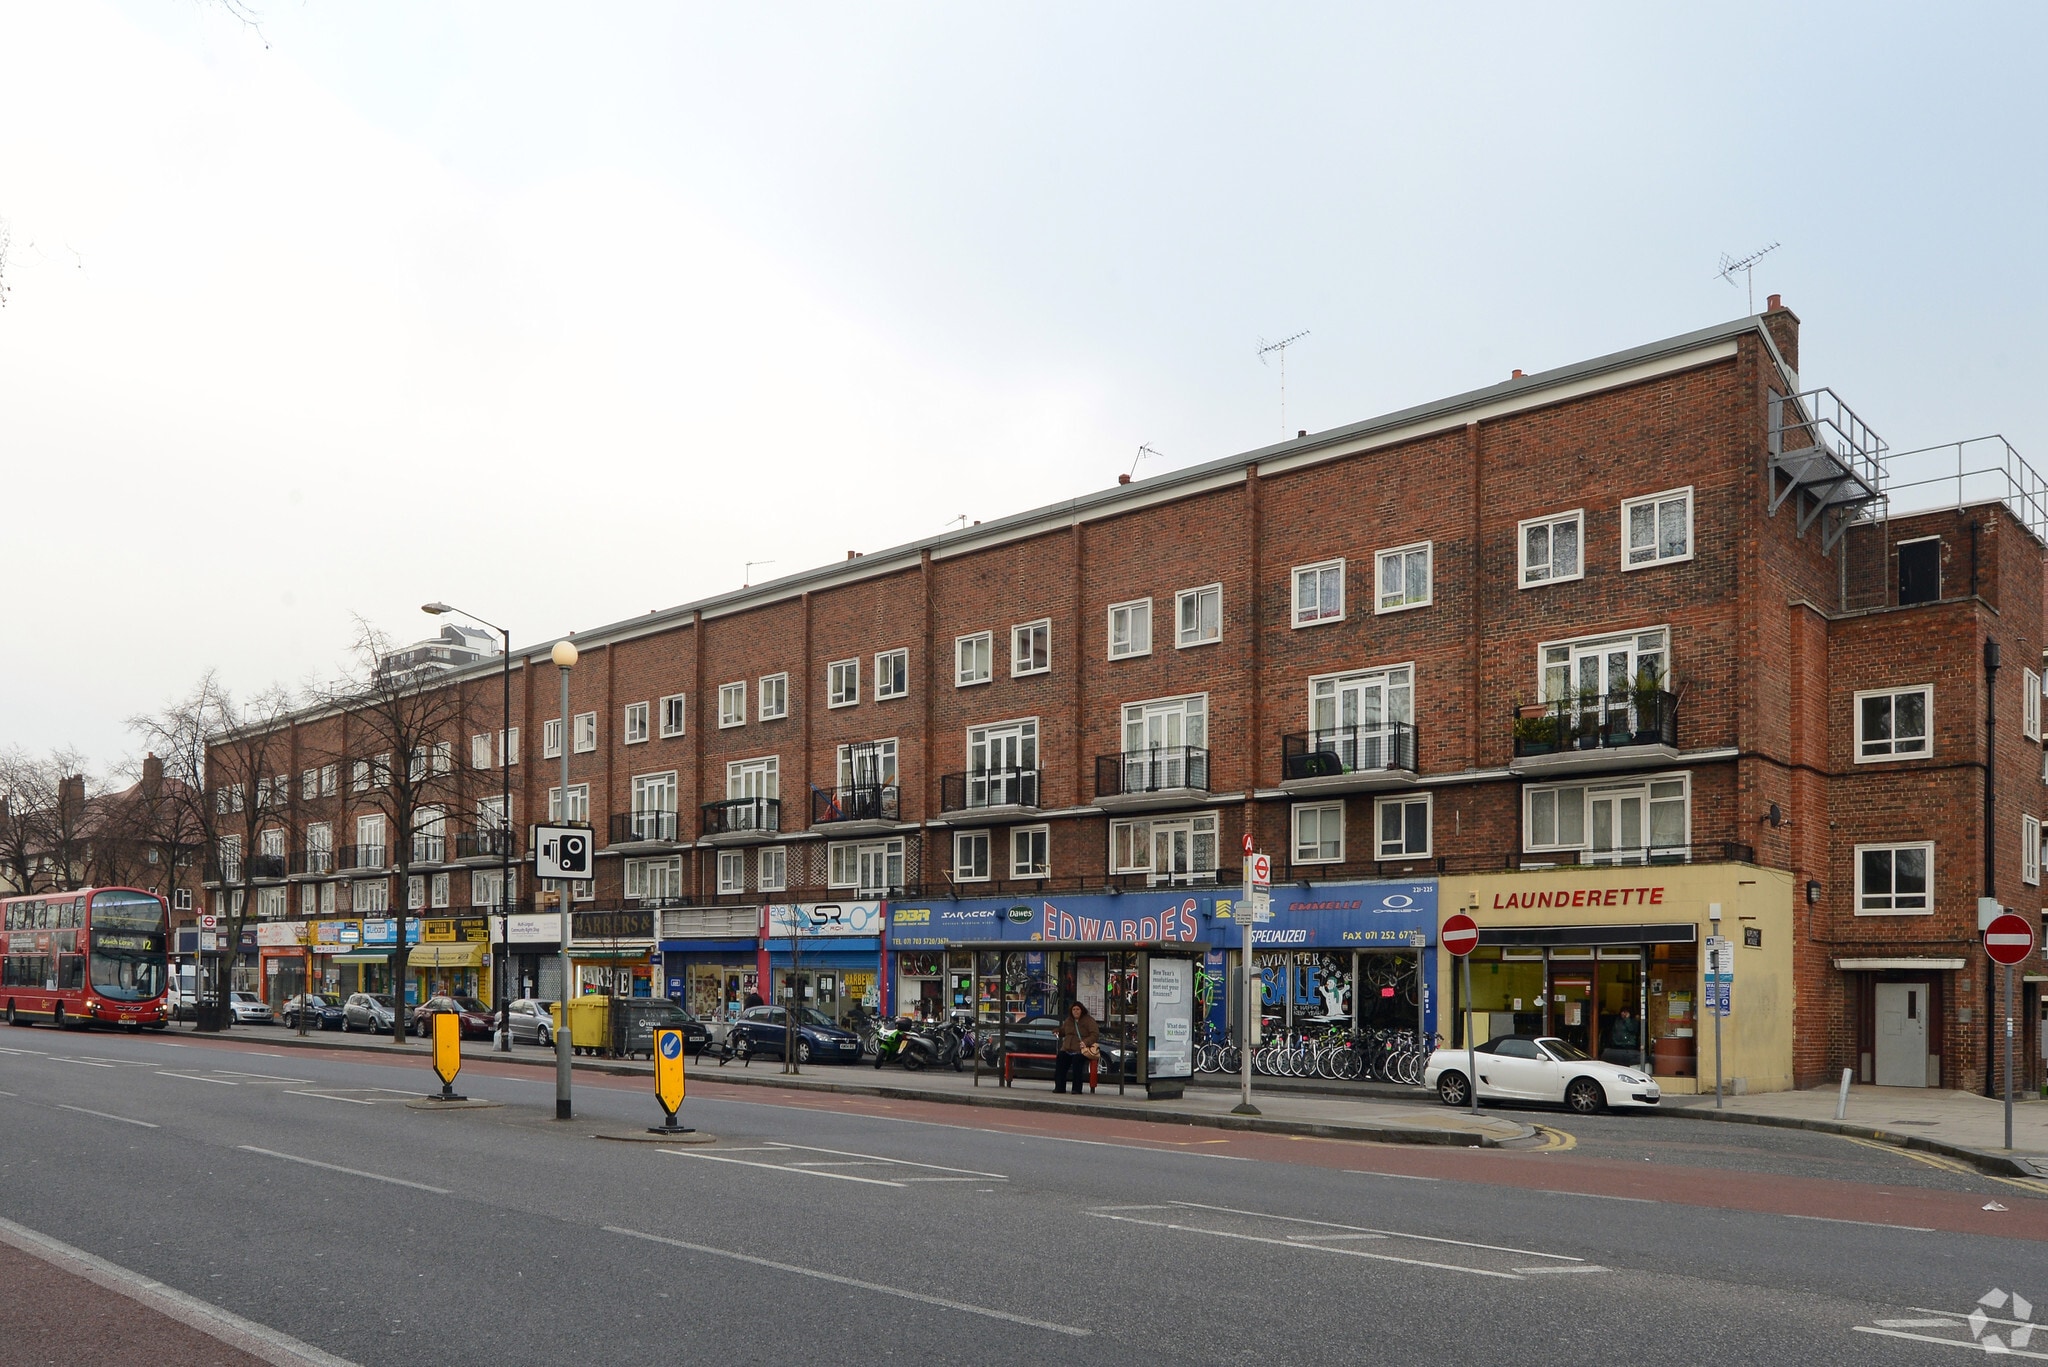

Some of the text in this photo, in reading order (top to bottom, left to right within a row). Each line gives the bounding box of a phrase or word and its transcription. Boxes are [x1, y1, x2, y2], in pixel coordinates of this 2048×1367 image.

[1245, 836, 1253, 851] A
[1493, 887, 1665, 909] LAUNDERETTE
[1288, 900, 1363, 911] EMMELLE
[893, 909, 931, 922] DBR
[941, 910, 996, 920] SARACEN
[1009, 909, 1033, 918] Dawes
[1043, 898, 1198, 942] EDWARDES
[575, 915, 651, 935] BARBERS &
[1251, 929, 1307, 943] SPECIALIZED
[1342, 931, 1362, 940] FAX
[1365, 931, 1378, 940] 071
[1381, 930, 1396, 940] 252
[142, 940, 152, 950] 12
[1261, 965, 1321, 1006] SALE
